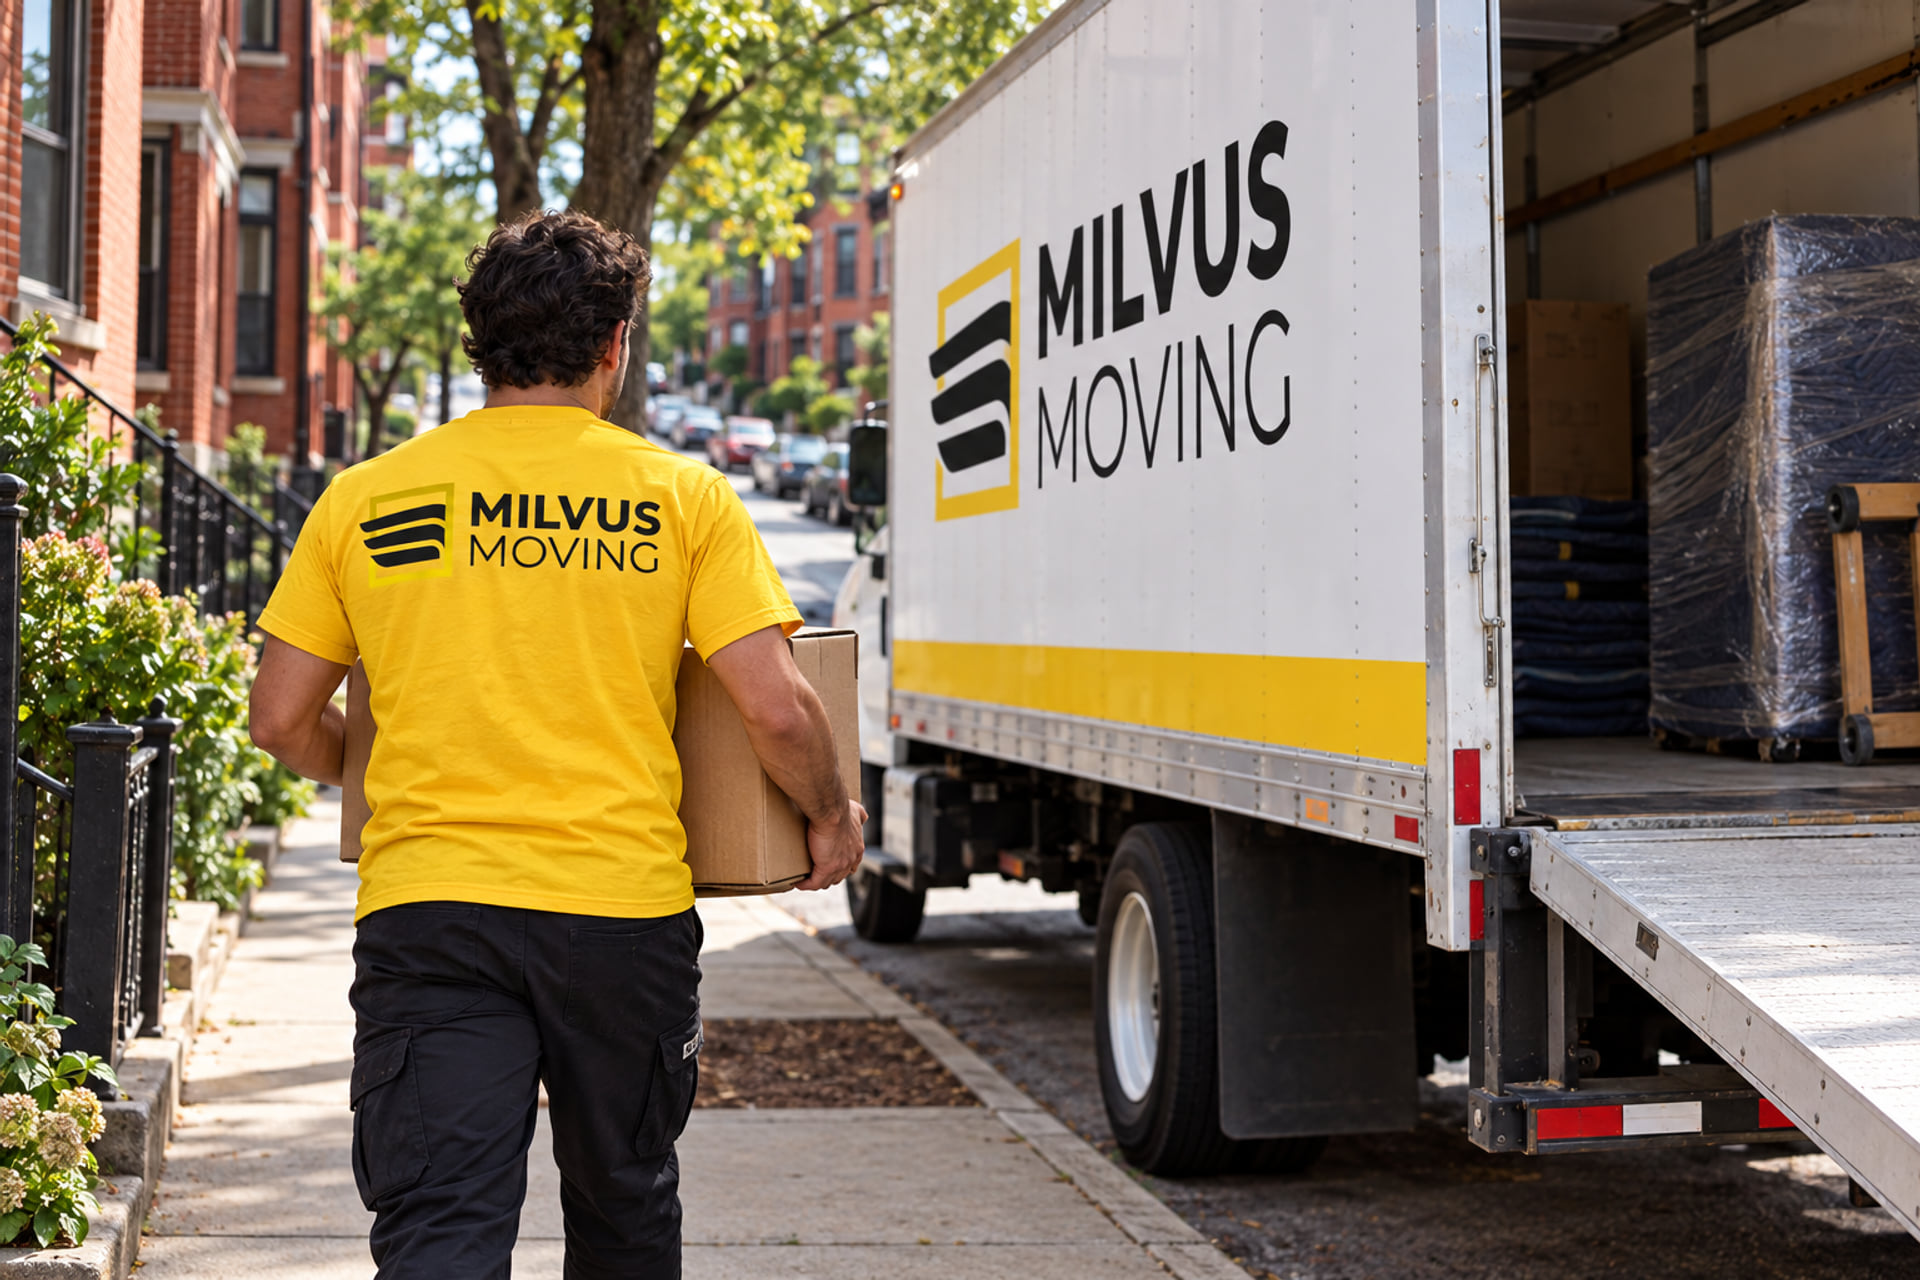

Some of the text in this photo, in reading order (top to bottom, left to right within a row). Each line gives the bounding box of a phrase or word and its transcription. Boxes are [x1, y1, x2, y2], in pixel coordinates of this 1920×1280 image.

[1038, 119, 1291, 360] MILVUS
[1038, 309, 1291, 489] MOVING
[470, 534, 659, 574] MOVING
[471, 491, 661, 536] MILVUS
